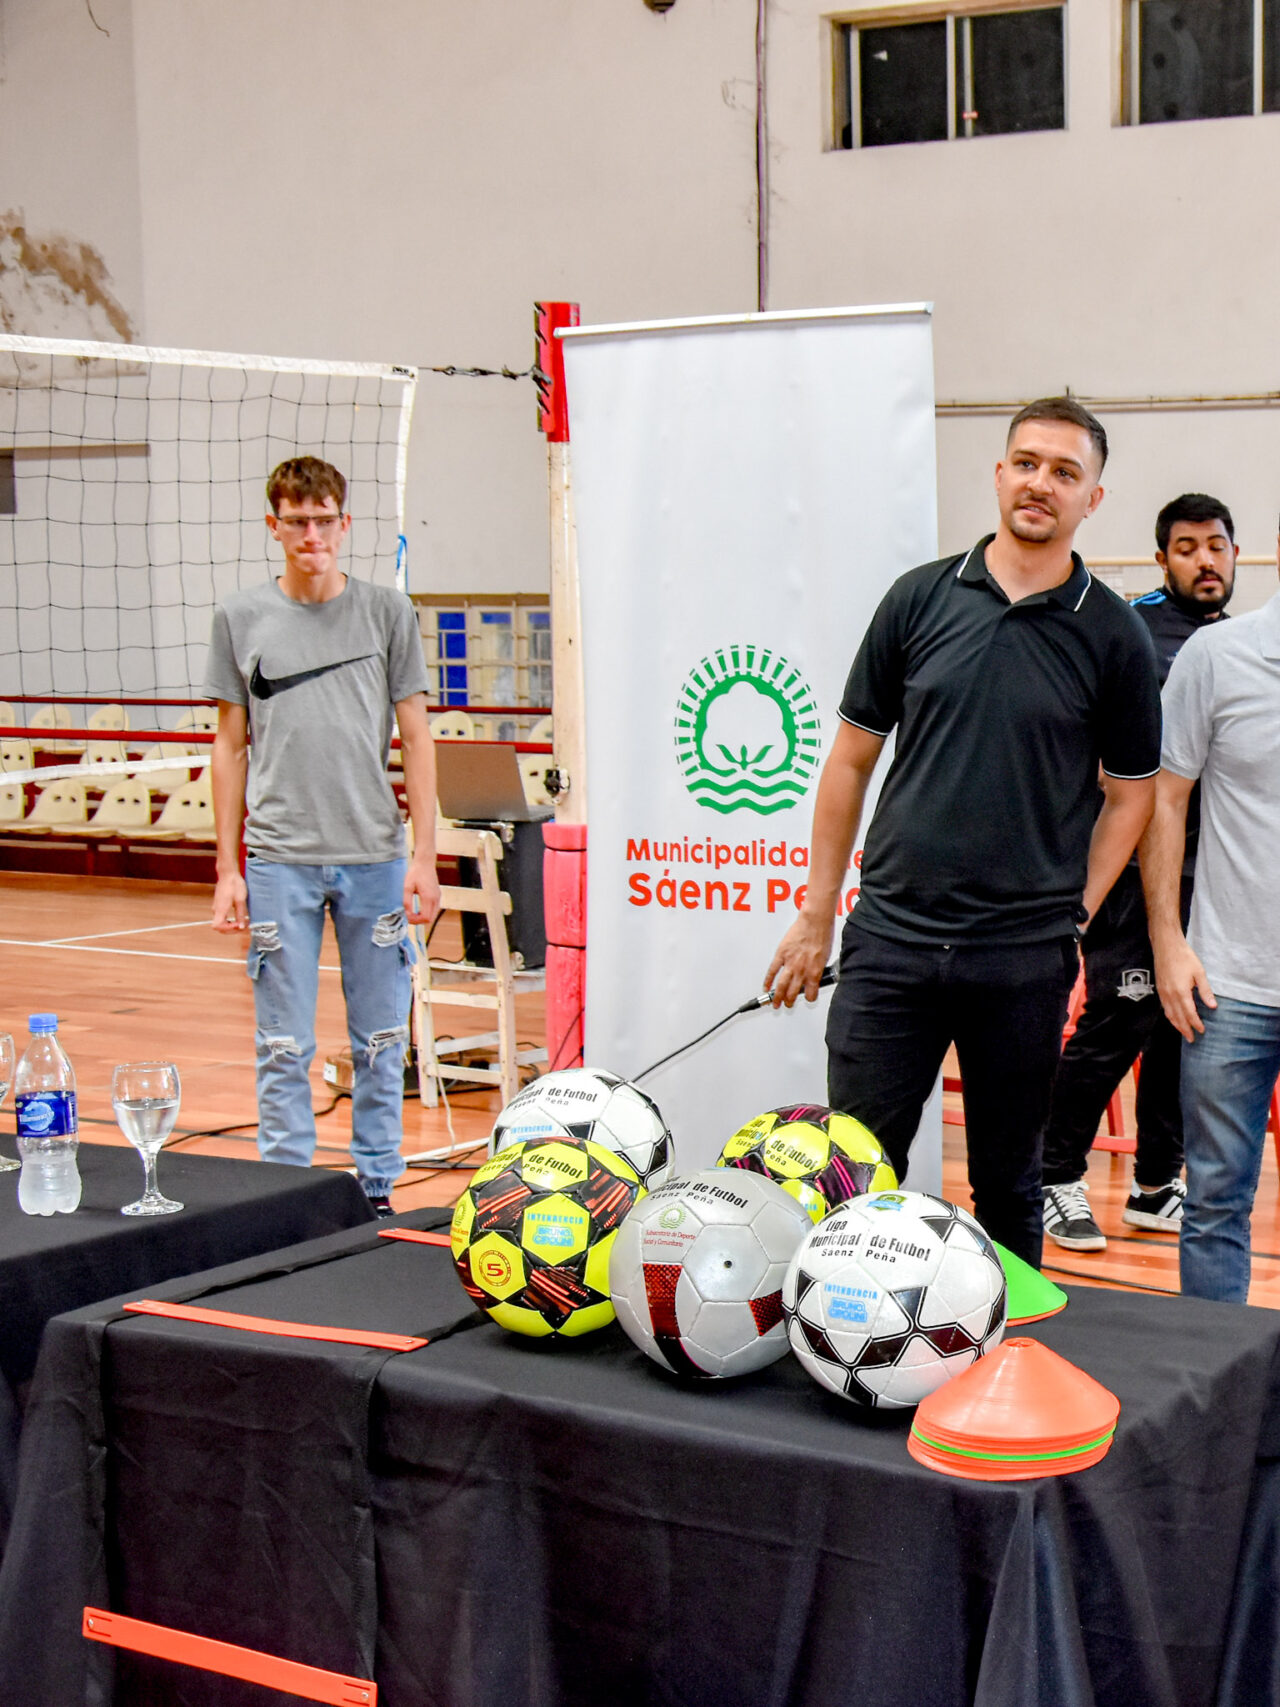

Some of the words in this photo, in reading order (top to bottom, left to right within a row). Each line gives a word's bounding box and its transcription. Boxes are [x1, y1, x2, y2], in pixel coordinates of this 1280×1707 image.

[626, 836, 809, 870] Municipalida
[628, 869, 751, 912] Sáenz
[548, 1087, 562, 1097] de
[563, 1088, 598, 1103] Futbol
[771, 1139, 784, 1152] de
[783, 1147, 818, 1171] Futbol
[529, 1153, 543, 1166] de
[544, 1156, 583, 1179] Futbol
[686, 1191, 714, 1205] Peña
[693, 1182, 707, 1193] de
[708, 1186, 749, 1209] Futbol
[826, 1220, 848, 1232] Liga
[809, 1233, 862, 1249] Municipal
[870, 1234, 887, 1249] de
[888, 1237, 931, 1262] Futbol
[865, 1249, 897, 1264] Peña
[487, 1263, 504, 1277] 5
[824, 1283, 878, 1300] INTENDENCIA
